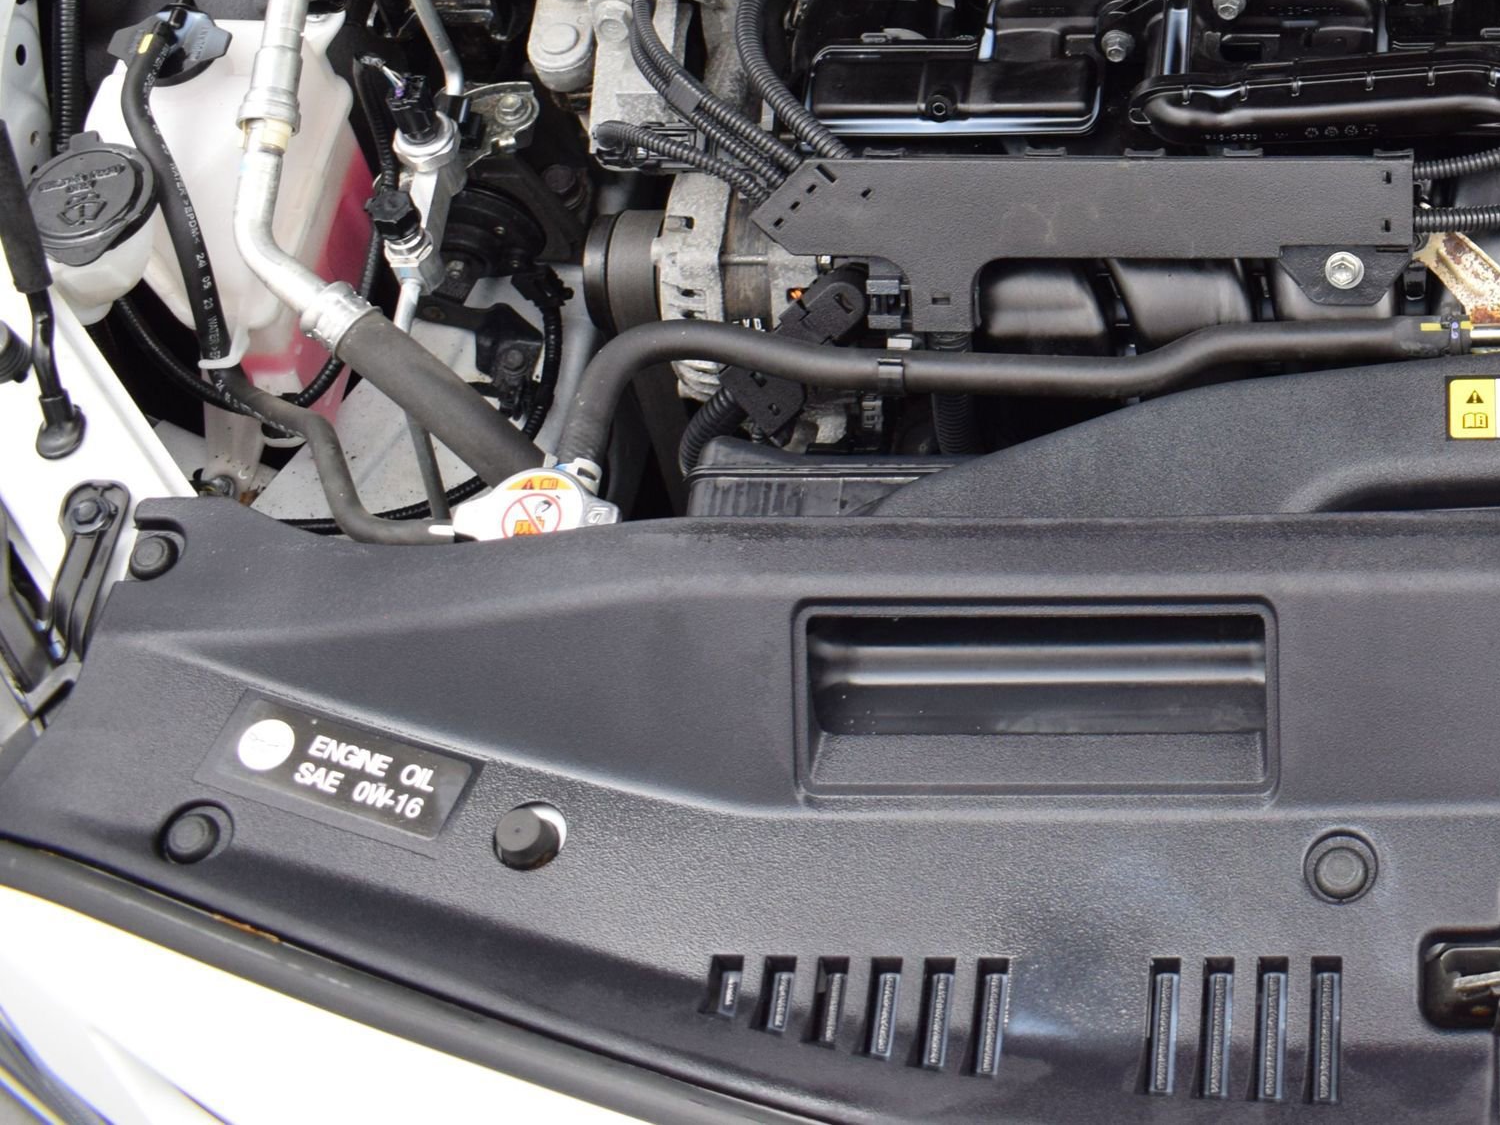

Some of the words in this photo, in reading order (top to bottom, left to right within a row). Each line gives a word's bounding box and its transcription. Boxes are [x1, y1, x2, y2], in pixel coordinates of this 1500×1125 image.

[195, 252, 208, 269] 24
[293, 762, 345, 793] SAE
[352, 779, 425, 818] 0W-16
[307, 734, 394, 778] ENGINE
[399, 763, 435, 793] OIL
